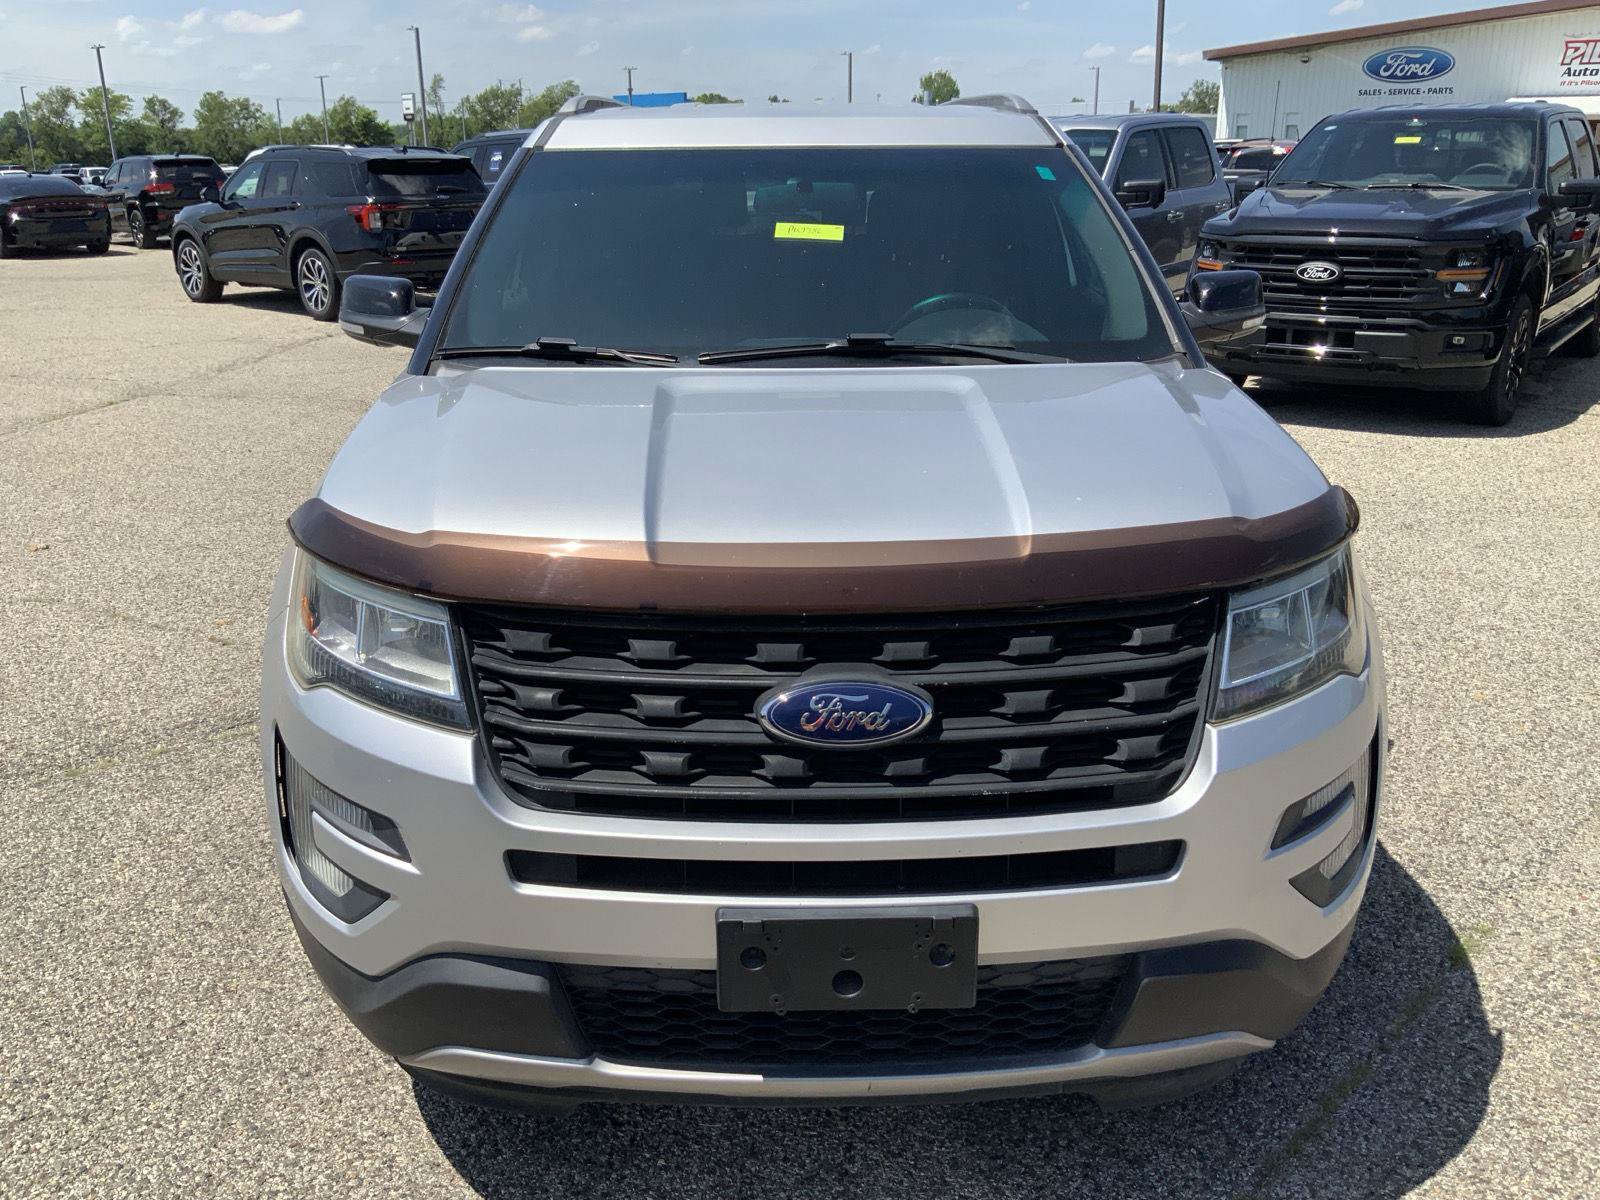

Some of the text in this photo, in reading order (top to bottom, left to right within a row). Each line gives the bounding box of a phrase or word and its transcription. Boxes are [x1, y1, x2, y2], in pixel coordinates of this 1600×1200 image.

[1380, 52, 1436, 77] Ford
[1560, 67, 1599, 77] Auto
[1358, 86, 1454, 97] SALES SERVICE PARTS
[1304, 267, 1331, 279] Ford
[800, 693, 893, 732] Ford
